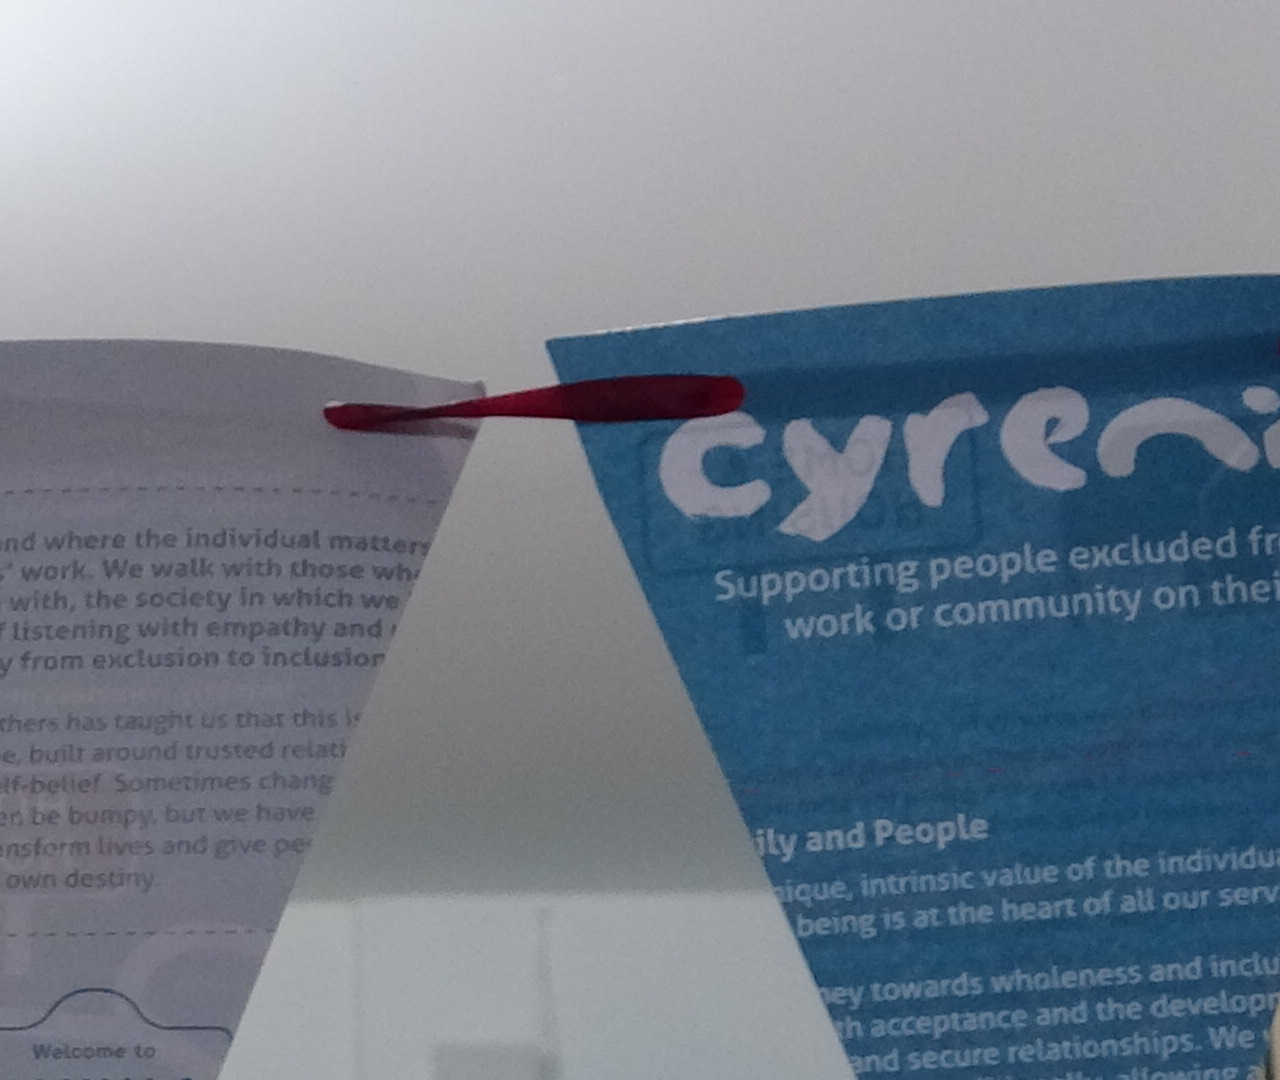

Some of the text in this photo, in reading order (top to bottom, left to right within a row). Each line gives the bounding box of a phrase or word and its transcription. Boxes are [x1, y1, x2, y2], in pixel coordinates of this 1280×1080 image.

[44, 530, 126, 552] where
[135, 527, 179, 549] the
[186, 527, 322, 549] individual
[102, 558, 144, 580] We
[151, 557, 216, 578] walk
[220, 557, 283, 578] with
[290, 558, 366, 580] those
[715, 529, 1237, 603] Supporting people excluded
[85, 588, 129, 610] the
[135, 587, 233, 613] society
[239, 586, 265, 607] in
[272, 587, 354, 608] which
[783, 604, 876, 640] work
[887, 606, 926, 632] or
[934, 585, 1142, 627] community
[1153, 585, 1202, 608] on
[13, 620, 131, 646] listening
[139, 617, 199, 639] with
[206, 615, 326, 644] empathy
[333, 618, 384, 639] and
[18, 650, 85, 671] from
[92, 648, 221, 670] exclusion
[227, 648, 256, 668] to
[66, 713, 108, 732] has
[92, 742, 178, 762] around
[186, 741, 274, 760] trusted
[115, 773, 251, 793] Sometimes
[256, 803, 316, 822] have
[806, 814, 990, 853] and People
[861, 852, 1150, 898] intrinsic value of the
[796, 909, 877, 938] being
[883, 905, 907, 929] is
[913, 907, 943, 928] at
[948, 902, 994, 927] the
[1001, 897, 1076, 923] heart
[1083, 891, 1114, 914] of
[1120, 885, 1155, 913] all
[1163, 890, 1211, 911] our
[871, 957, 1202, 1004] towards wholeness and
[871, 995, 1142, 1039] acceptance and the
[32, 1043, 157, 1060] Welcome to
[907, 1025, 1255, 1070] secure relationships. We
